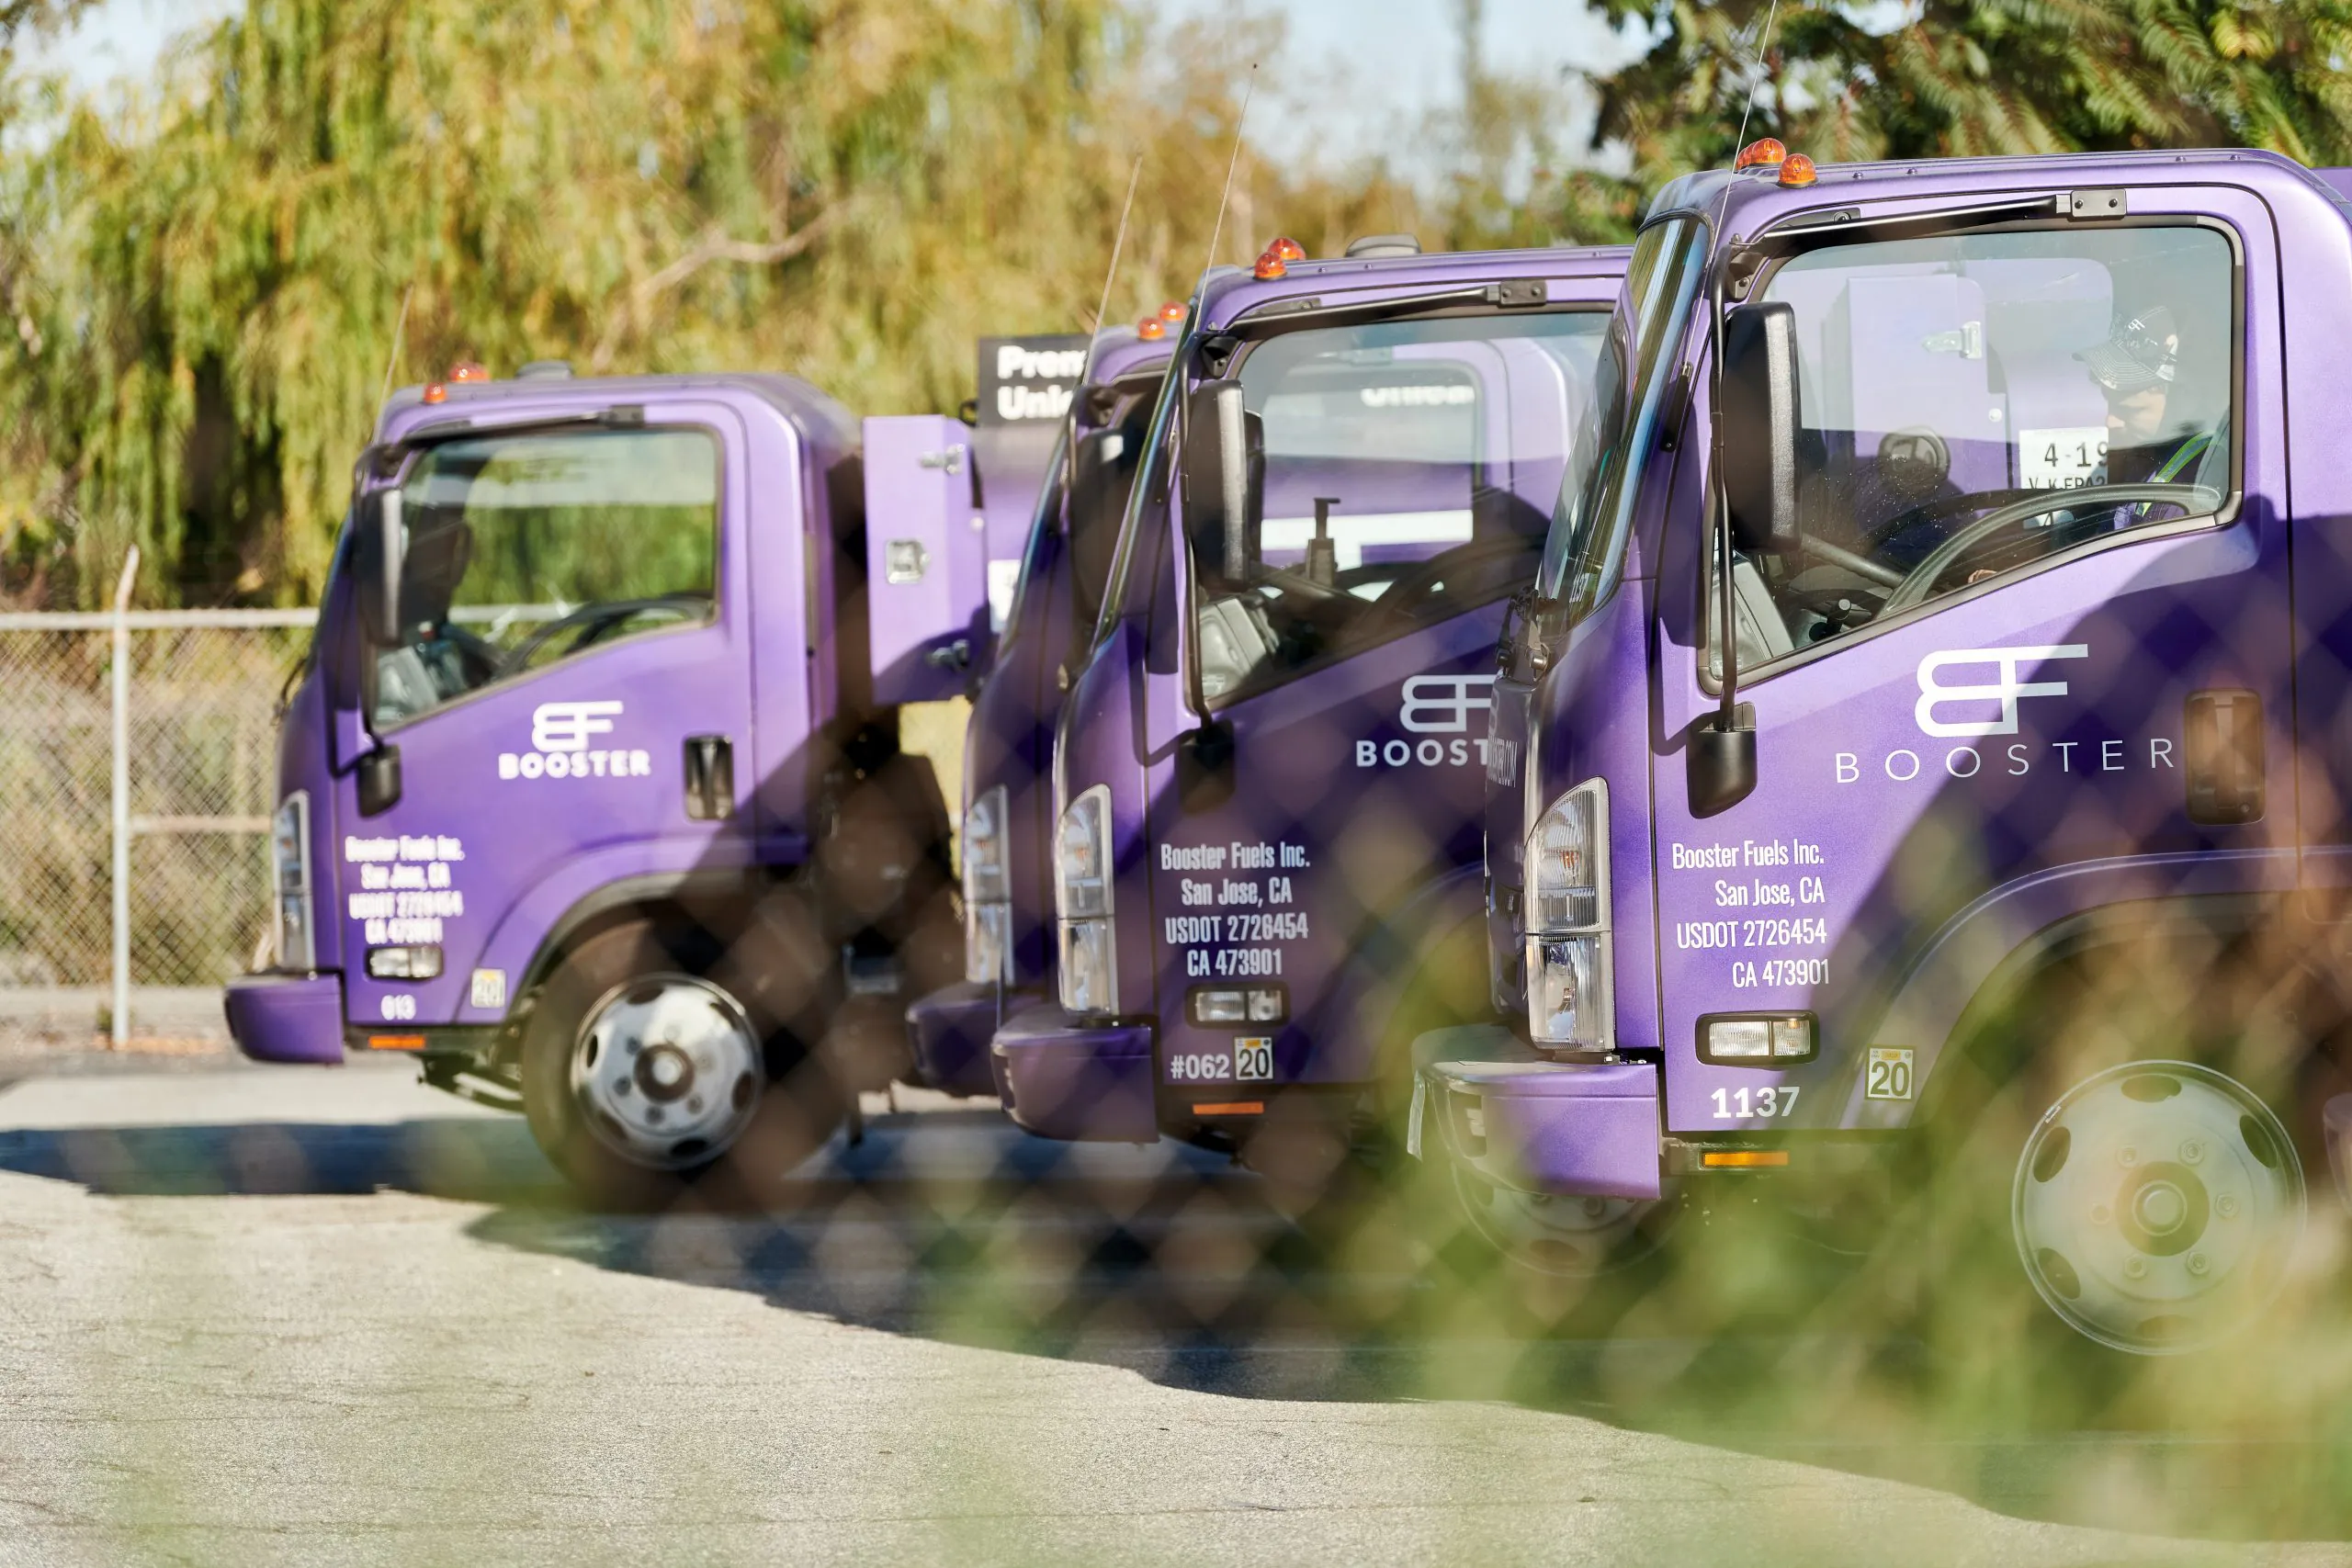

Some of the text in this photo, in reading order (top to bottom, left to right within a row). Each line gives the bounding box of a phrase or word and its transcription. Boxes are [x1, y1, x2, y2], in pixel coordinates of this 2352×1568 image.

[498, 750, 650, 780] BOOSTER
[1836, 738, 2174, 784] BOOSTER
[1161, 841, 1310, 870] Booster Fuels Inc.
[1672, 838, 1825, 869] Booster Fuels Inc.
[1181, 876, 1292, 908] San Jose, CA
[1715, 876, 1825, 907] San Jose, CA
[1165, 912, 1308, 944] USDOT 2726454
[1677, 919, 1826, 949] USDOT 2726454
[1187, 948, 1282, 976] CA 473901
[1733, 958, 1829, 987] CA 473901
[1170, 1055, 1230, 1079] #062
[1239, 1048, 1269, 1077] 20
[1871, 1061, 1909, 1097] 20
[1711, 1087, 1800, 1118] 1137
